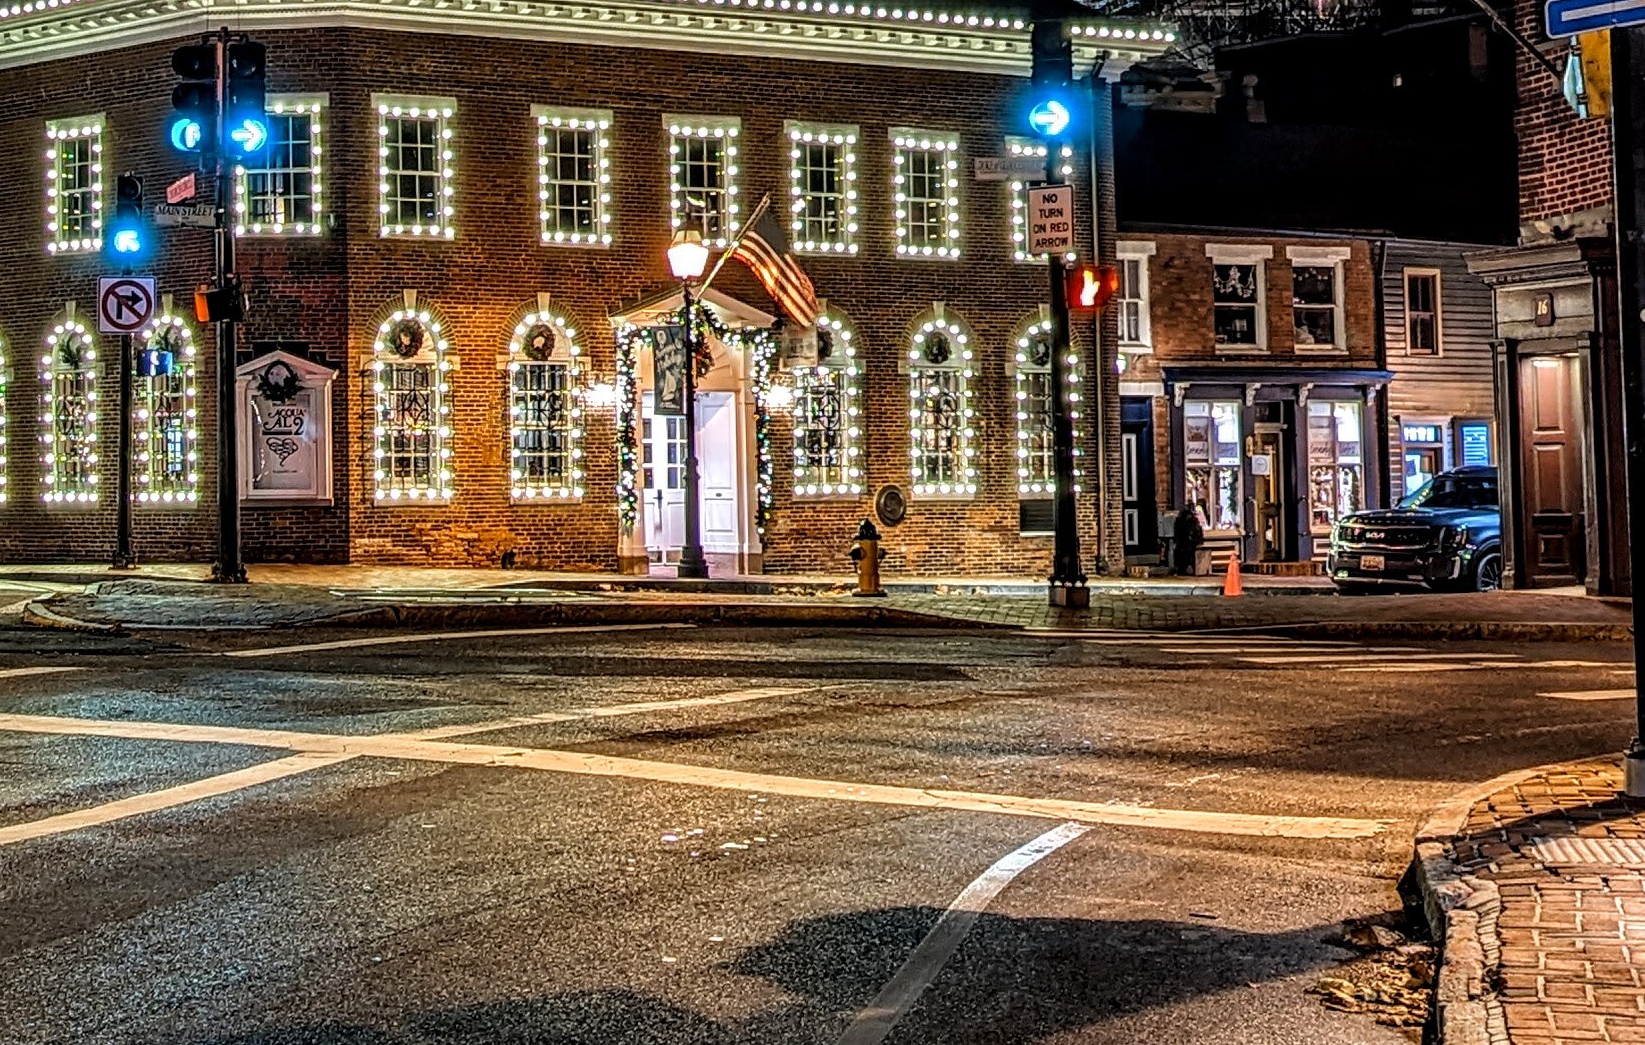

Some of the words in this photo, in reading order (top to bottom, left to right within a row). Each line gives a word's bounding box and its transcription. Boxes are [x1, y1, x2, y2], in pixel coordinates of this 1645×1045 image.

[1042, 193, 1058, 204] NO
[156, 205, 181, 215] MAIN
[181, 206, 214, 216] STREET
[1038, 208, 1064, 219] TURN
[1032, 224, 1047, 234] ON
[1050, 222, 1069, 233] RED
[1034, 237, 1069, 248] ARROW
[1537, 299, 1549, 315] 16
[268, 408, 305, 419] ACQUA
[263, 415, 293, 431] AL
[293, 416, 305, 436] 2
